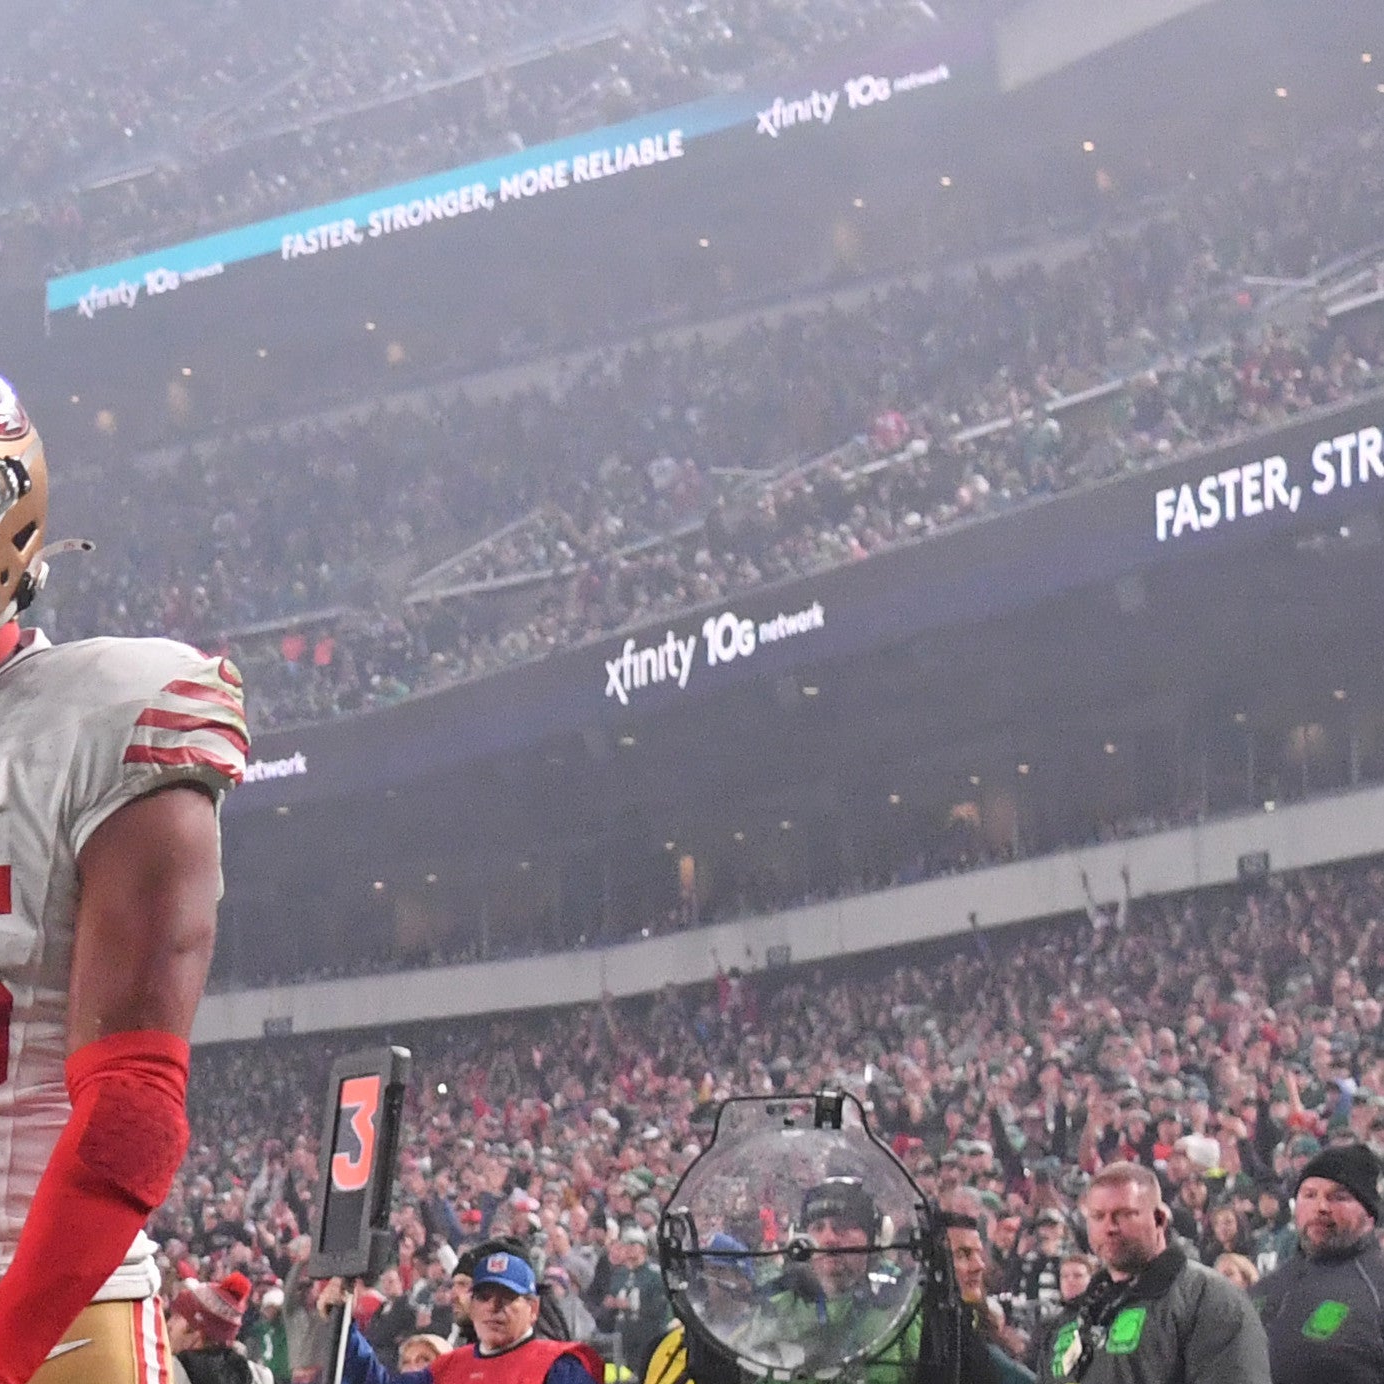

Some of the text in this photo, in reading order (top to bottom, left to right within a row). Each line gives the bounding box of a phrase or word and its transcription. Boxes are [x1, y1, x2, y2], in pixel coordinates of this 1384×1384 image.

[755, 90, 839, 138] xfinity
[281, 129, 684, 261] FASTER, STRONGER, MORE RELIABLE
[77, 279, 140, 319] xfinity
[1155, 455, 1302, 542] FASTER,
[604, 600, 826, 706] xfinity 10G network
[332, 1074, 380, 1191] 3
